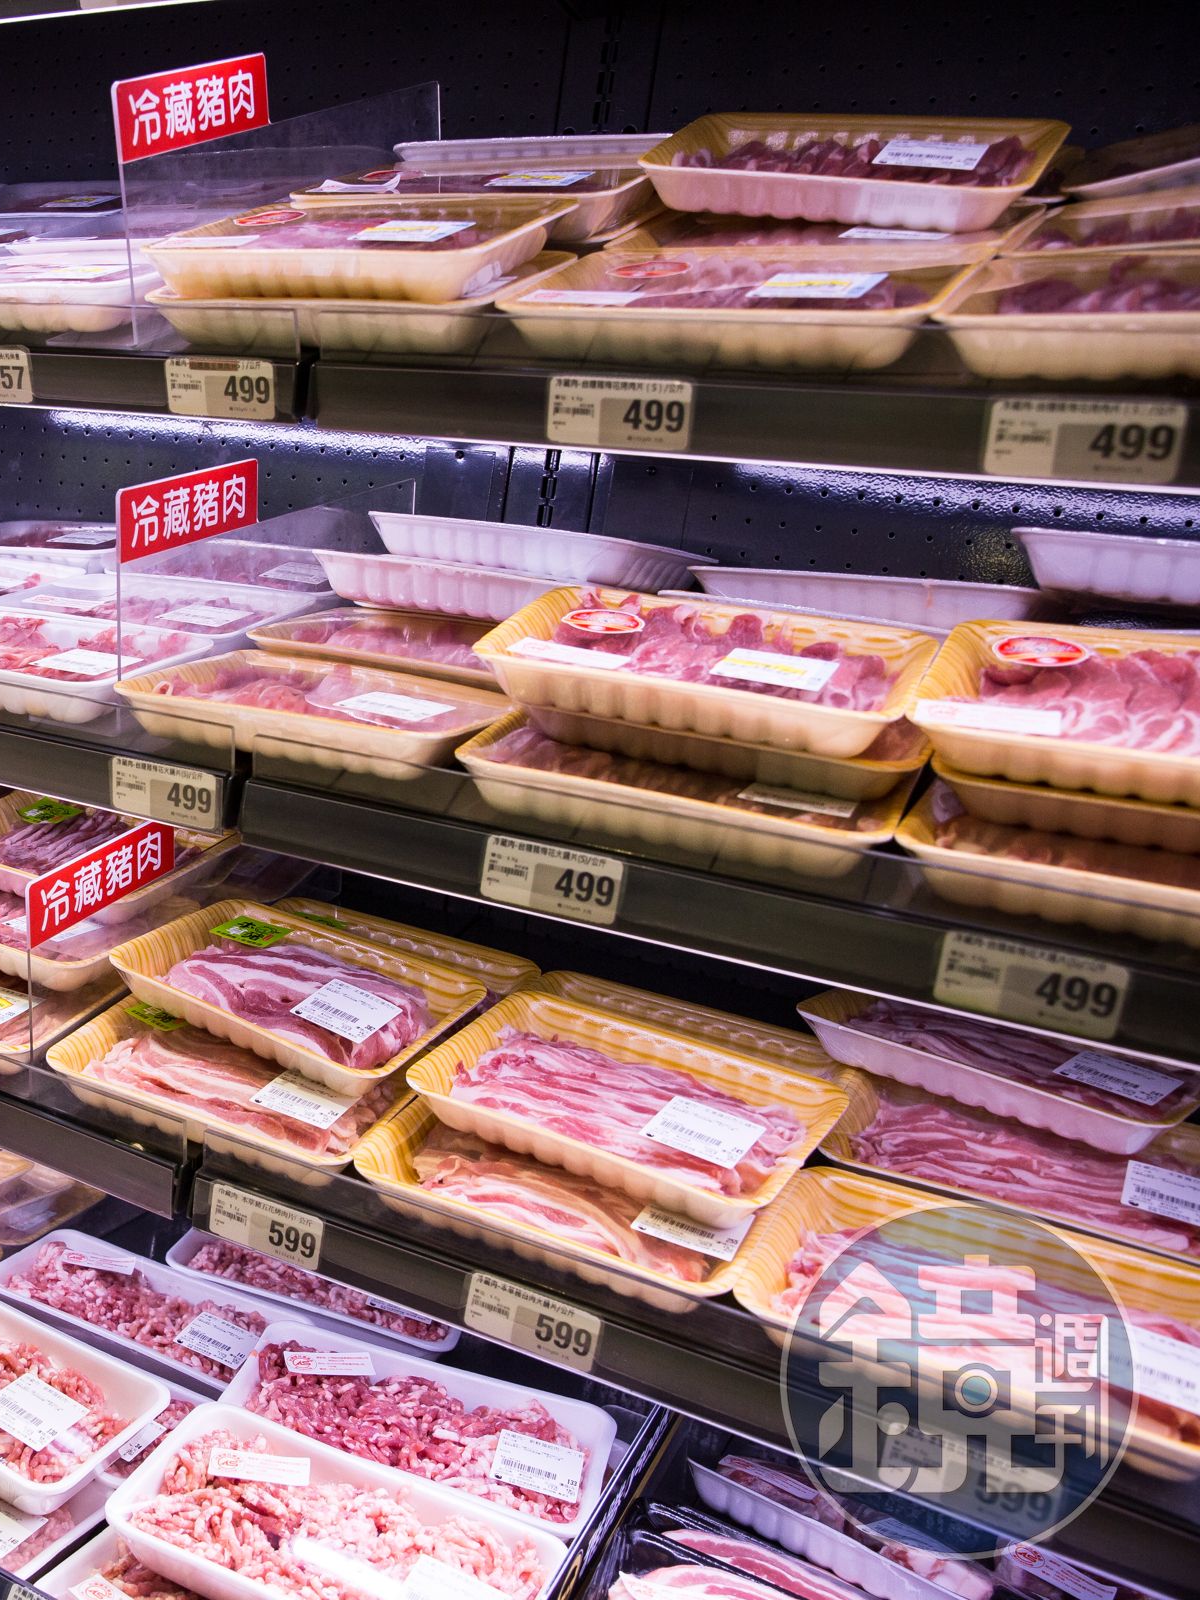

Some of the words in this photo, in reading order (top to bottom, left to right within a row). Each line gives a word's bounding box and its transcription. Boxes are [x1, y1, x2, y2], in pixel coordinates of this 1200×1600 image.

[129, 68, 256, 146] 冷藏豬肉
[224, 375, 270, 404] 499
[623, 399, 685, 432] 499
[1089, 423, 1175, 461] 499
[131, 473, 246, 548] 冷藏豬肉
[166, 782, 211, 813] 499
[40, 831, 161, 932] 冷藏豬肉
[555, 868, 615, 906] 499
[1035, 972, 1118, 1018] 499
[268, 1219, 316, 1258] 599
[534, 1313, 592, 1356] 599
[975, 1473, 1056, 1523] 599
